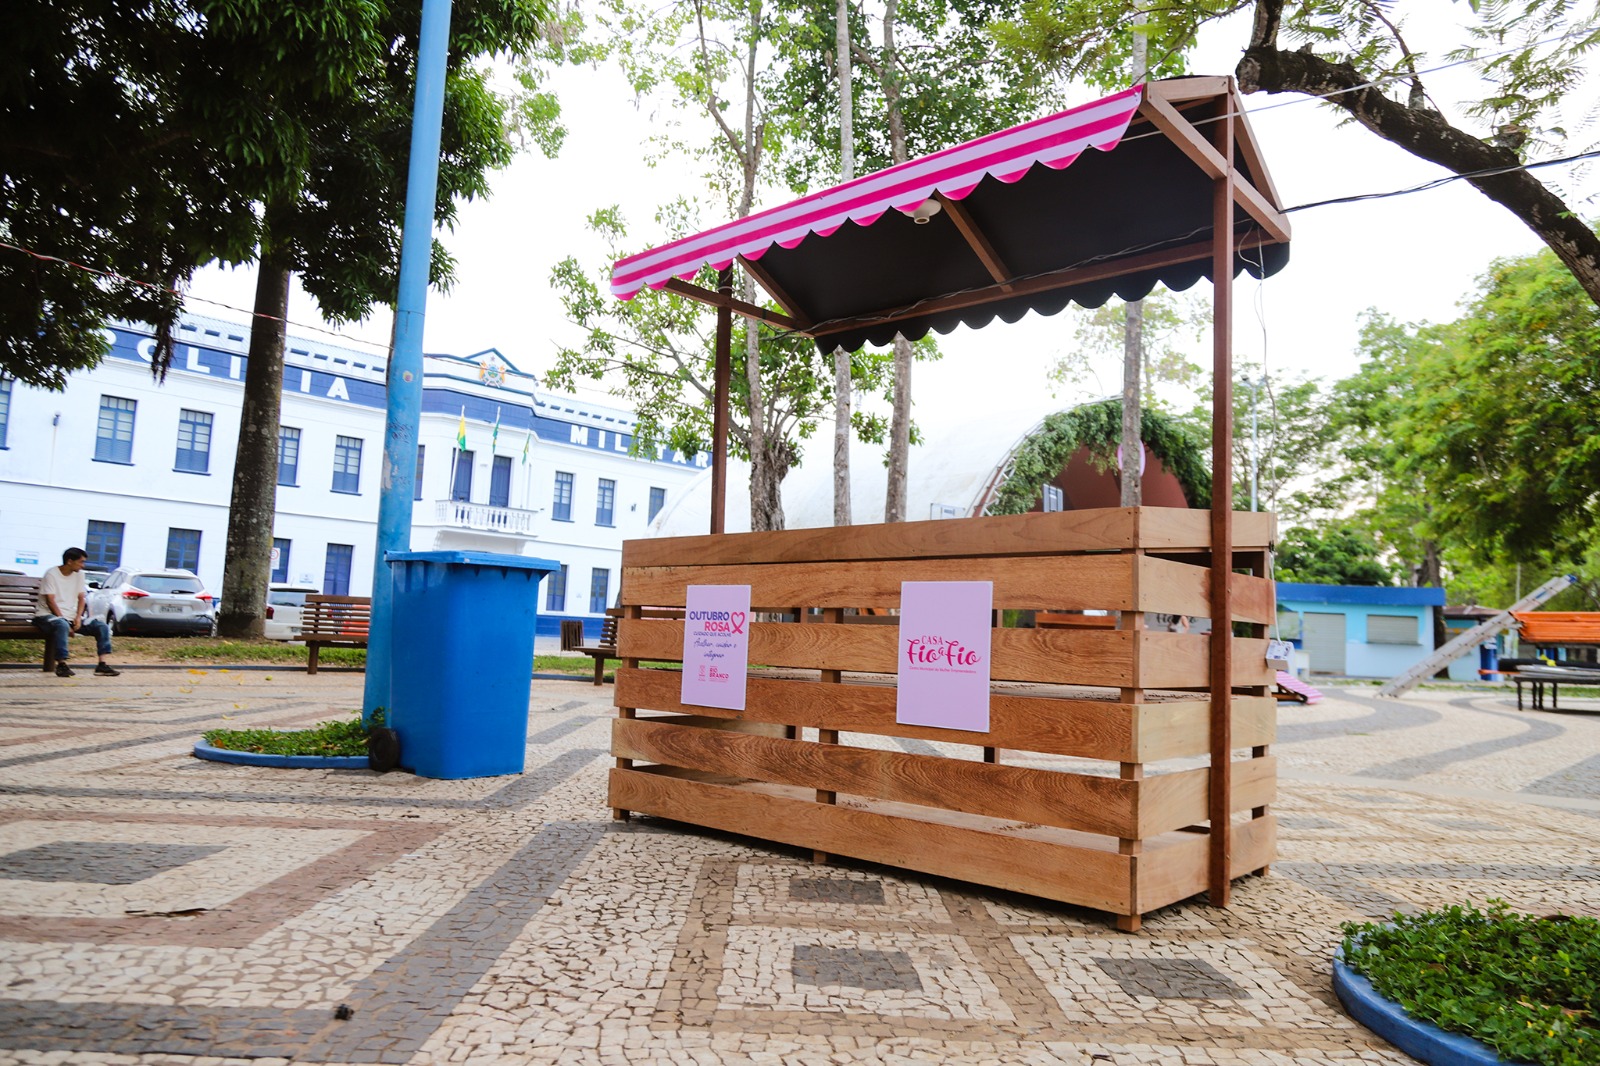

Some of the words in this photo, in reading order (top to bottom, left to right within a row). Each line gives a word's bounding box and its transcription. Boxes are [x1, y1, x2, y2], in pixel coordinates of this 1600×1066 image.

[96, 328, 350, 401] OLIIA
[689, 611, 730, 621] OUTUBRO
[704, 621, 730, 632] ROSA
[921, 635, 944, 645] CASA
[907, 638, 941, 665] Fio
[938, 646, 946, 656] a
[945, 640, 982, 667] Fio
